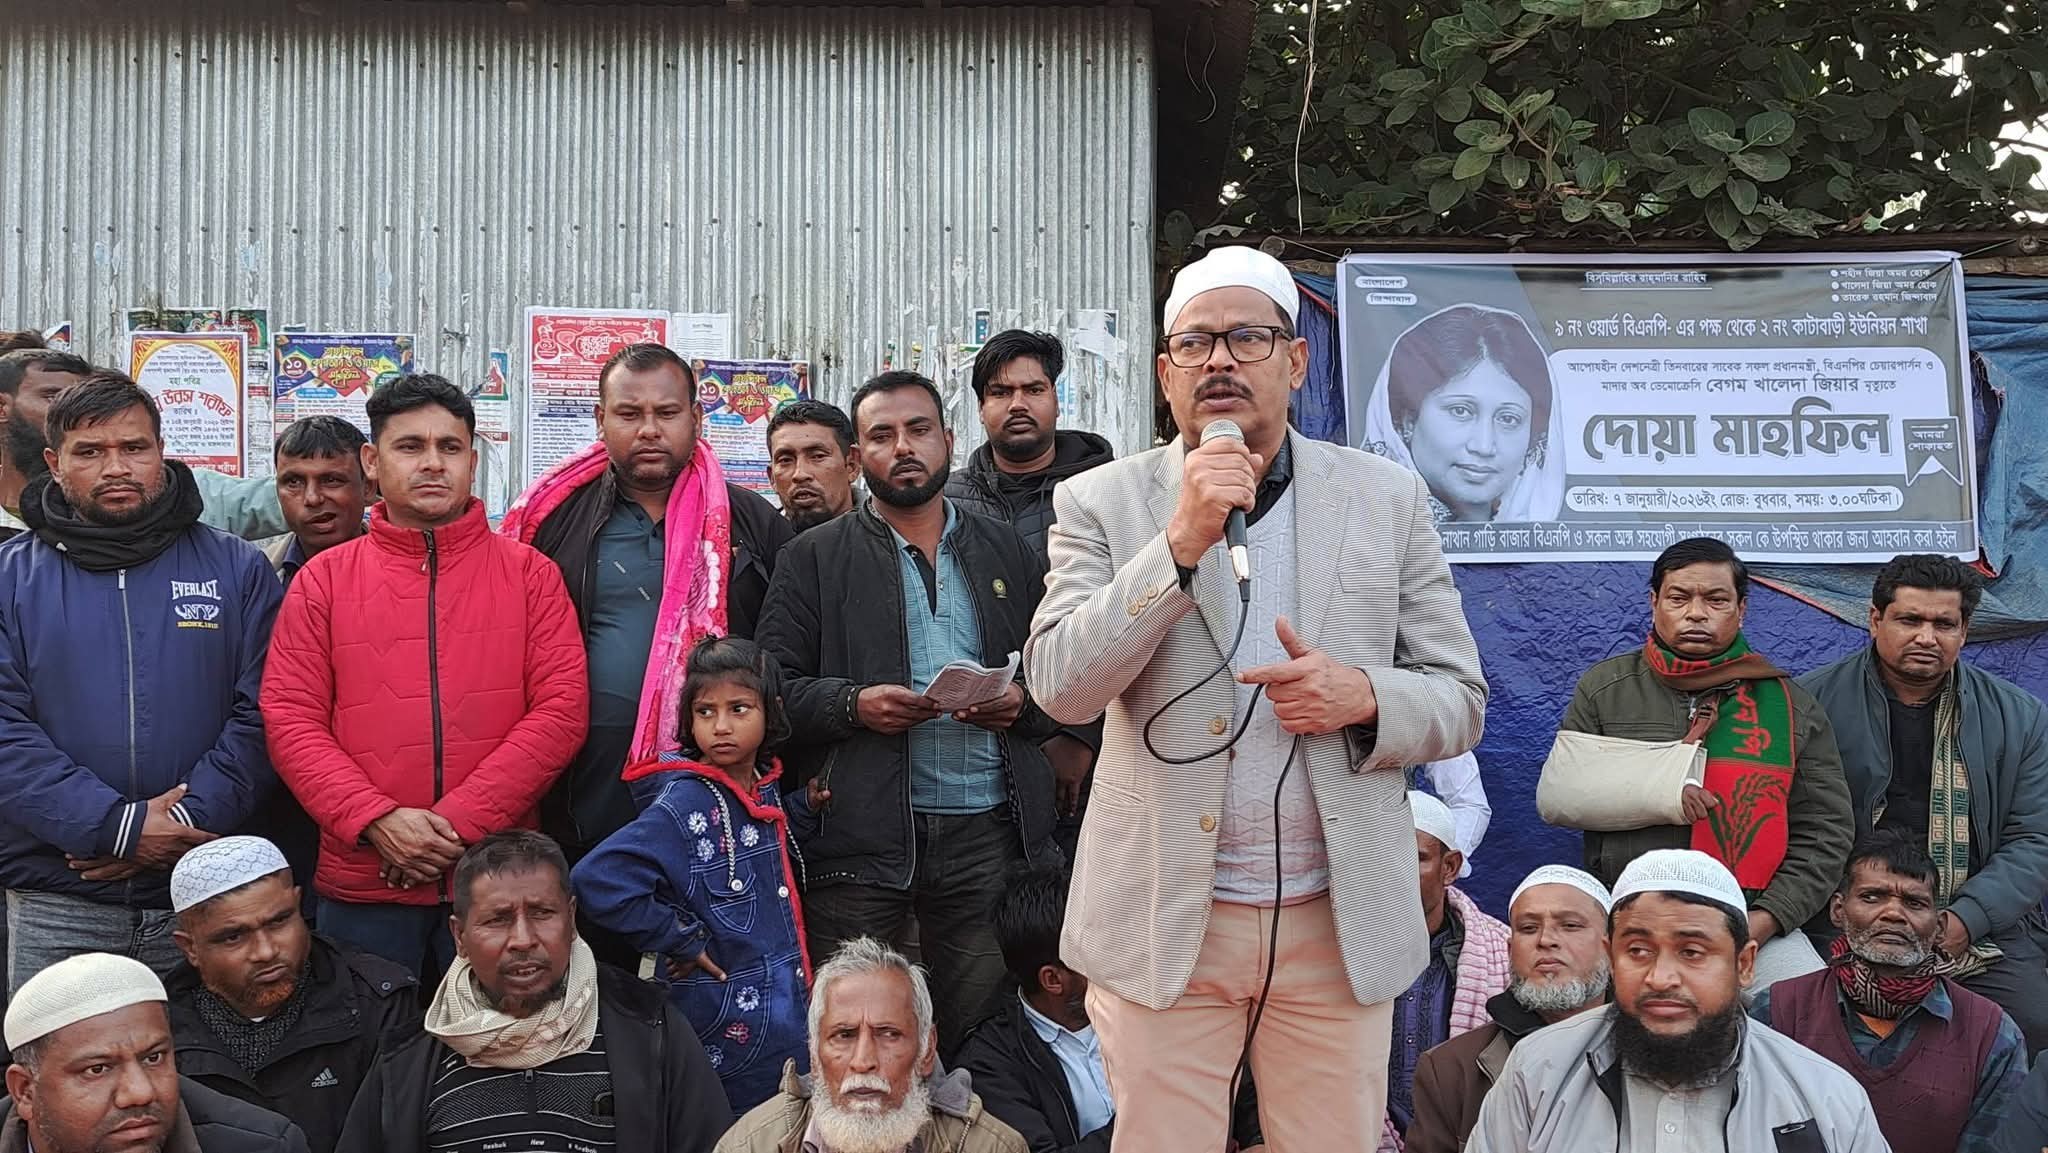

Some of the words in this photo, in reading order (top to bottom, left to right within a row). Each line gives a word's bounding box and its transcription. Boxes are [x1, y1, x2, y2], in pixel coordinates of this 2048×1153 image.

[1555, 319, 1564, 337] ৯
[1568, 319, 1583, 338] নং
[1586, 313, 1620, 337] ওয়ার্ড
[1676, 319, 1694, 337] এর
[1699, 319, 1722, 337] পক্ষ
[1726, 319, 1756, 337] থেকে
[1760, 320, 1769, 337] ২
[1772, 319, 1787, 338] নং
[1792, 312, 1846, 338] কাটাবাড়ী
[1849, 311, 1897, 337] ইউনিয়ন
[1900, 316, 1928, 336] শাখা
[1620, 359, 1661, 373] দেশনেত্রী
[1664, 359, 1708, 373] তিনবারের
[1712, 361, 1742, 372] সাবেক
[1746, 361, 1769, 372] সফল
[1824, 358, 1866, 371] বিএনপির
[1926, 361, 1934, 371] ও
[1601, 380, 1627, 392] মাদার
[1706, 378, 1747, 393] বেগম
[1754, 377, 1807, 392] খালেদা
[1813, 373, 1859, 393] জিয়ার
[1864, 380, 1897, 393] মৃত্যুতে
[1583, 414, 1696, 462] দোয়া
[1710, 396, 1890, 457] মাহফিল
[1912, 430, 1945, 440] আমরা
[1572, 488, 1609, 505] তারিখ:
[1614, 494, 1622, 506] ৭
[1721, 493, 1750, 506] রোজ:
[1754, 494, 1792, 509] বুধবার,
[1795, 494, 1824, 507] সময়:
[1474, 524, 1496, 551] গাড়ি
[1500, 530, 1530, 548] বাজার
[1534, 523, 1570, 548] বিএনপি
[1574, 530, 1582, 546] ও
[1586, 530, 1612, 547] সকল
[1614, 530, 1634, 547] অঙ্গ
[1636, 524, 1675, 548] সহযোগী
[1727, 530, 1752, 547] সকল
[1756, 530, 1769, 548] কে
[1772, 524, 1809, 550] উপস্থিত
[1812, 530, 1843, 548] থাকার
[1847, 530, 1868, 548] জন্য
[1914, 529, 1934, 547] করা
[1936, 523, 1958, 548] হইল
[171, 580, 222, 600] EVERLAST
[182, 604, 214, 620] NY
